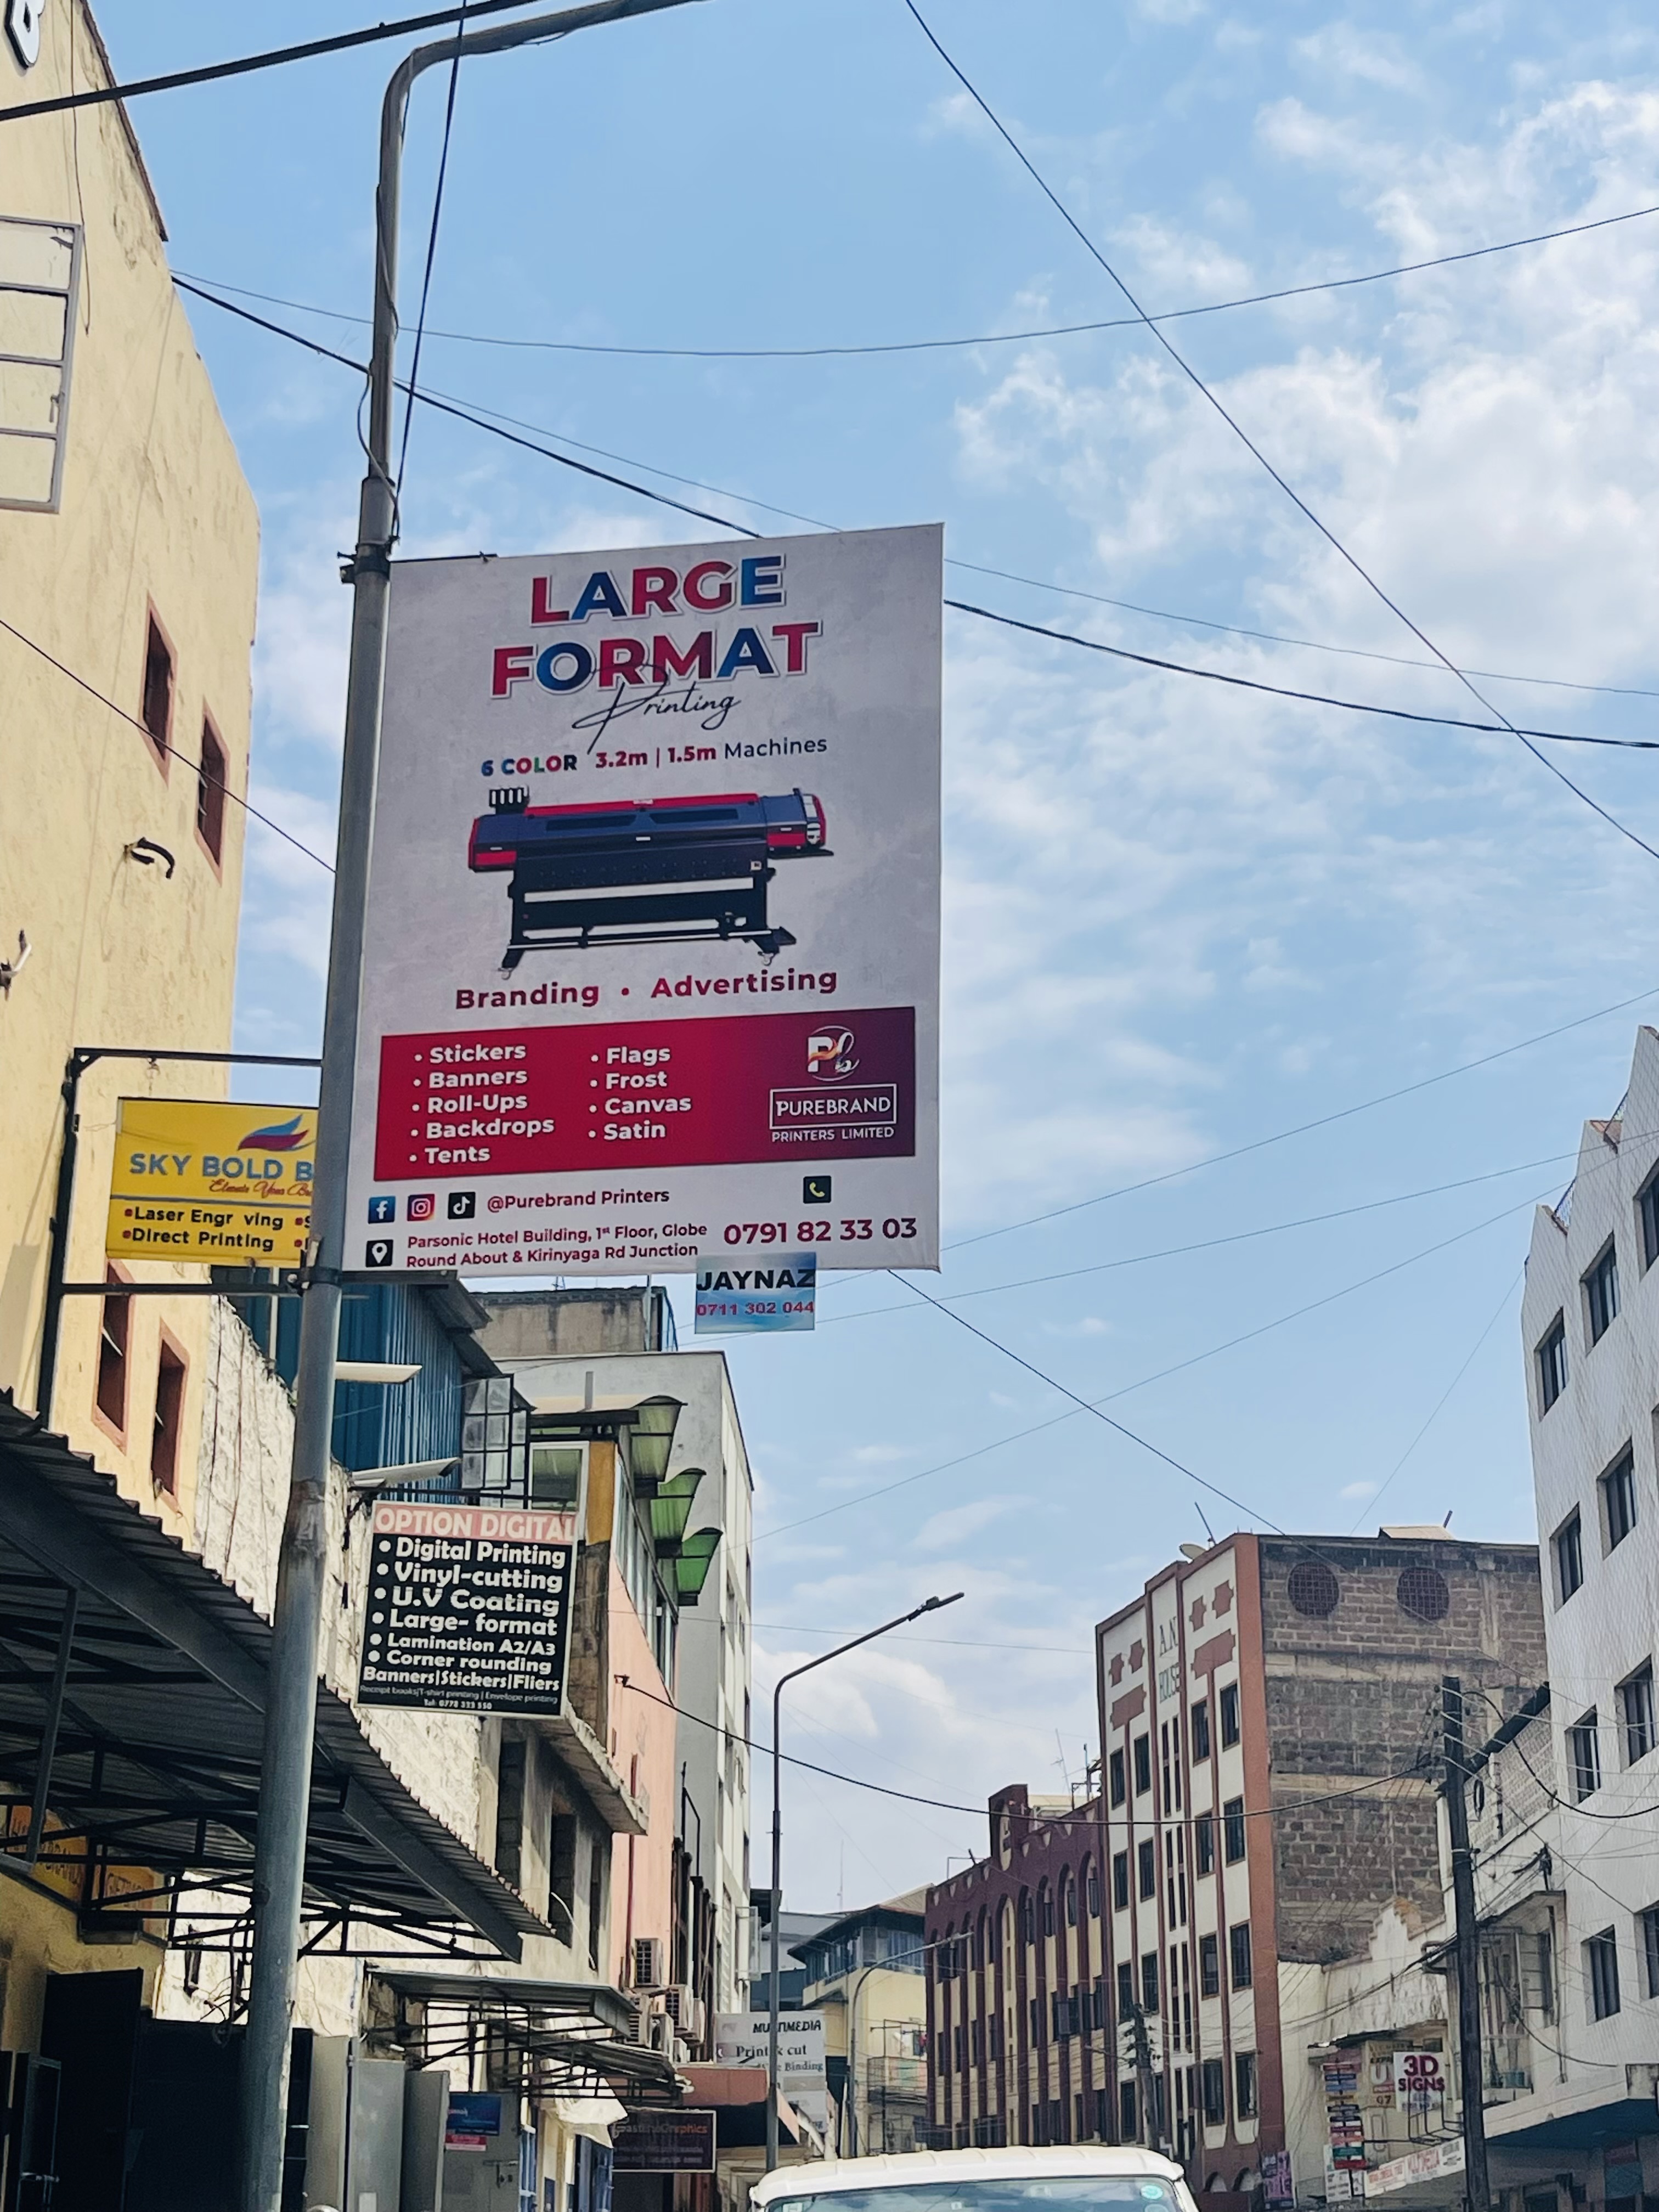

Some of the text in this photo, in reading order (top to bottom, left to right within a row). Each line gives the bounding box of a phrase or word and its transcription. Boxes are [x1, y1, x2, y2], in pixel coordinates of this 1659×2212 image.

[531, 555, 785, 624] LARGE
[493, 622, 820, 697] FORMAT
[572, 662, 741, 754] Printing
[481, 760, 493, 776] 6
[501, 754, 578, 775] COLOR
[595, 751, 648, 769] 3.2m
[668, 746, 716, 764] 1.5m
[724, 737, 828, 759] Machines
[651, 968, 838, 998] Advertising
[456, 981, 600, 1009] Branding
[429, 1044, 527, 1064] Stickers
[607, 1046, 671, 1066] Flags
[428, 1070, 528, 1088] Banners
[606, 1070, 668, 1089] Frost
[428, 1094, 528, 1114] Roll-Ups
[605, 1097, 692, 1115] Canvas
[776, 1097, 891, 1116] PUREBRAND
[426, 1118, 555, 1139] Backdrops
[603, 1120, 666, 1141] Satin
[772, 1127, 894, 1142] PRINTERS LIMITED
[130, 1153, 191, 1176] SKY
[202, 1155, 284, 1180] BOLD
[425, 1146, 490, 1164] Tents
[487, 1189, 670, 1213] @Purebrand Printers
[134, 1206, 184, 1222] Laser
[132, 1227, 274, 1252] Direct Printing
[408, 1232, 473, 1249] Parsonic
[478, 1231, 518, 1245] Hotel
[523, 1228, 592, 1243] Building,
[615, 1225, 658, 1241] Floor,
[662, 1223, 707, 1237] Globe
[723, 1217, 917, 1245] 0791 82 33 03
[407, 1243, 698, 1268] Round About & Kirinyaga Rd Junction
[696, 1268, 816, 1291] JAYNAZ
[696, 1301, 815, 1316] 0711 302 044
[375, 1506, 576, 1542] OPTION DIGITAL
[396, 1536, 566, 1569] Digital Printing
[394, 1561, 563, 1593] Vinyl-cutting
[392, 1585, 560, 1617] U.V Coating
[390, 1609, 557, 1636] Large- format
[387, 1632, 556, 1656] Lamination A2/A3
[387, 1650, 552, 1675] Corner rounding
[752, 2019, 821, 2034] MUTIMEDIA
[736, 2045, 768, 2058] Print
[787, 2045, 807, 2056] cut
[784, 2061, 823, 2073] Binding
[1403, 2055, 1439, 2076] 3D
[1398, 2076, 1446, 2092] SIGNS
